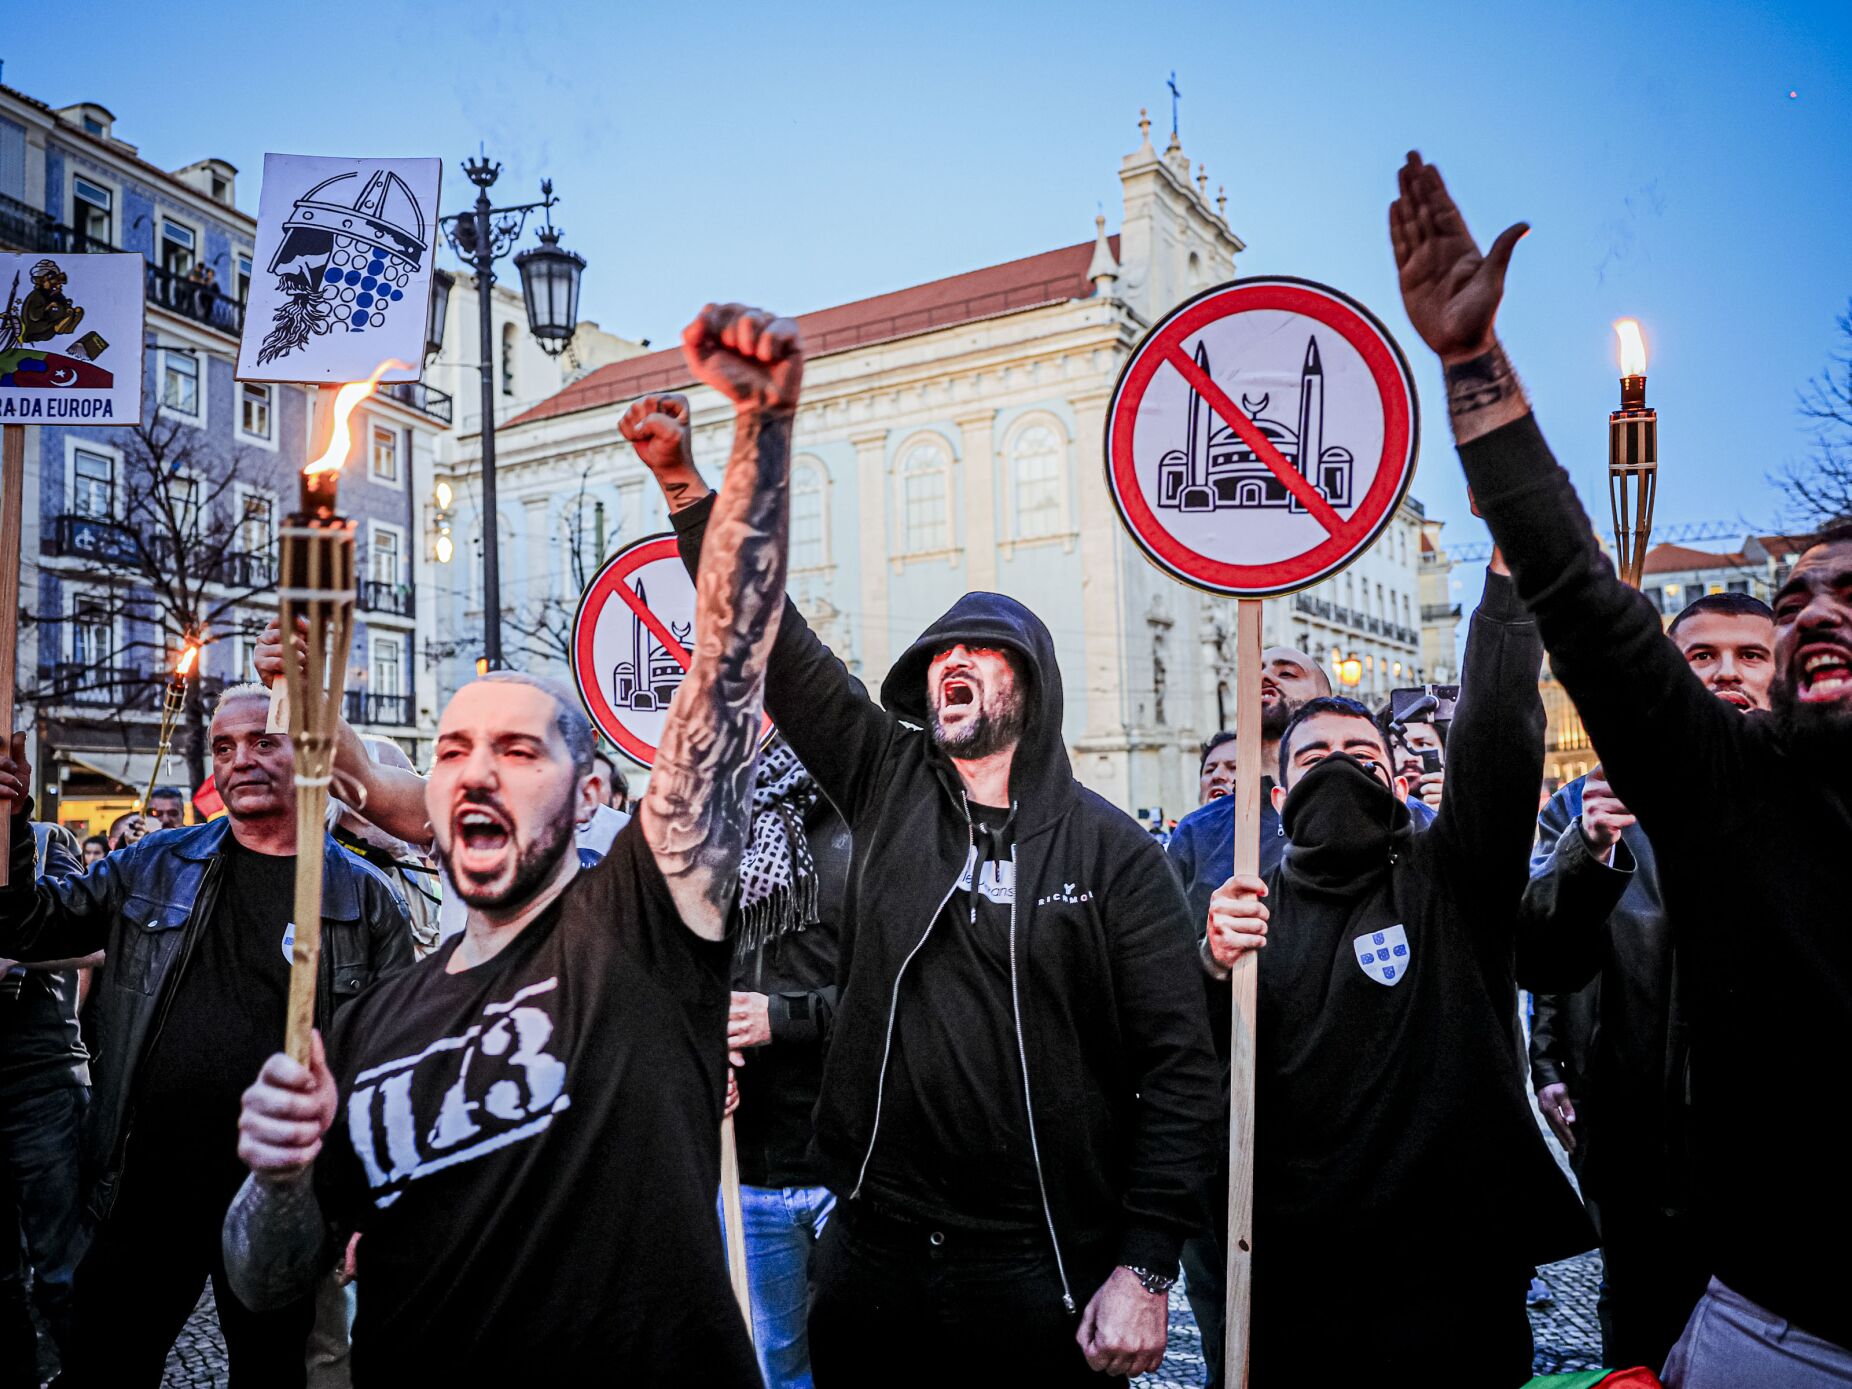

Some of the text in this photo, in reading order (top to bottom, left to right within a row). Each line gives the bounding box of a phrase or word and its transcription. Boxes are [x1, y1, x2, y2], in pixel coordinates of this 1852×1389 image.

[0, 397, 113, 418] A DA EUROPA
